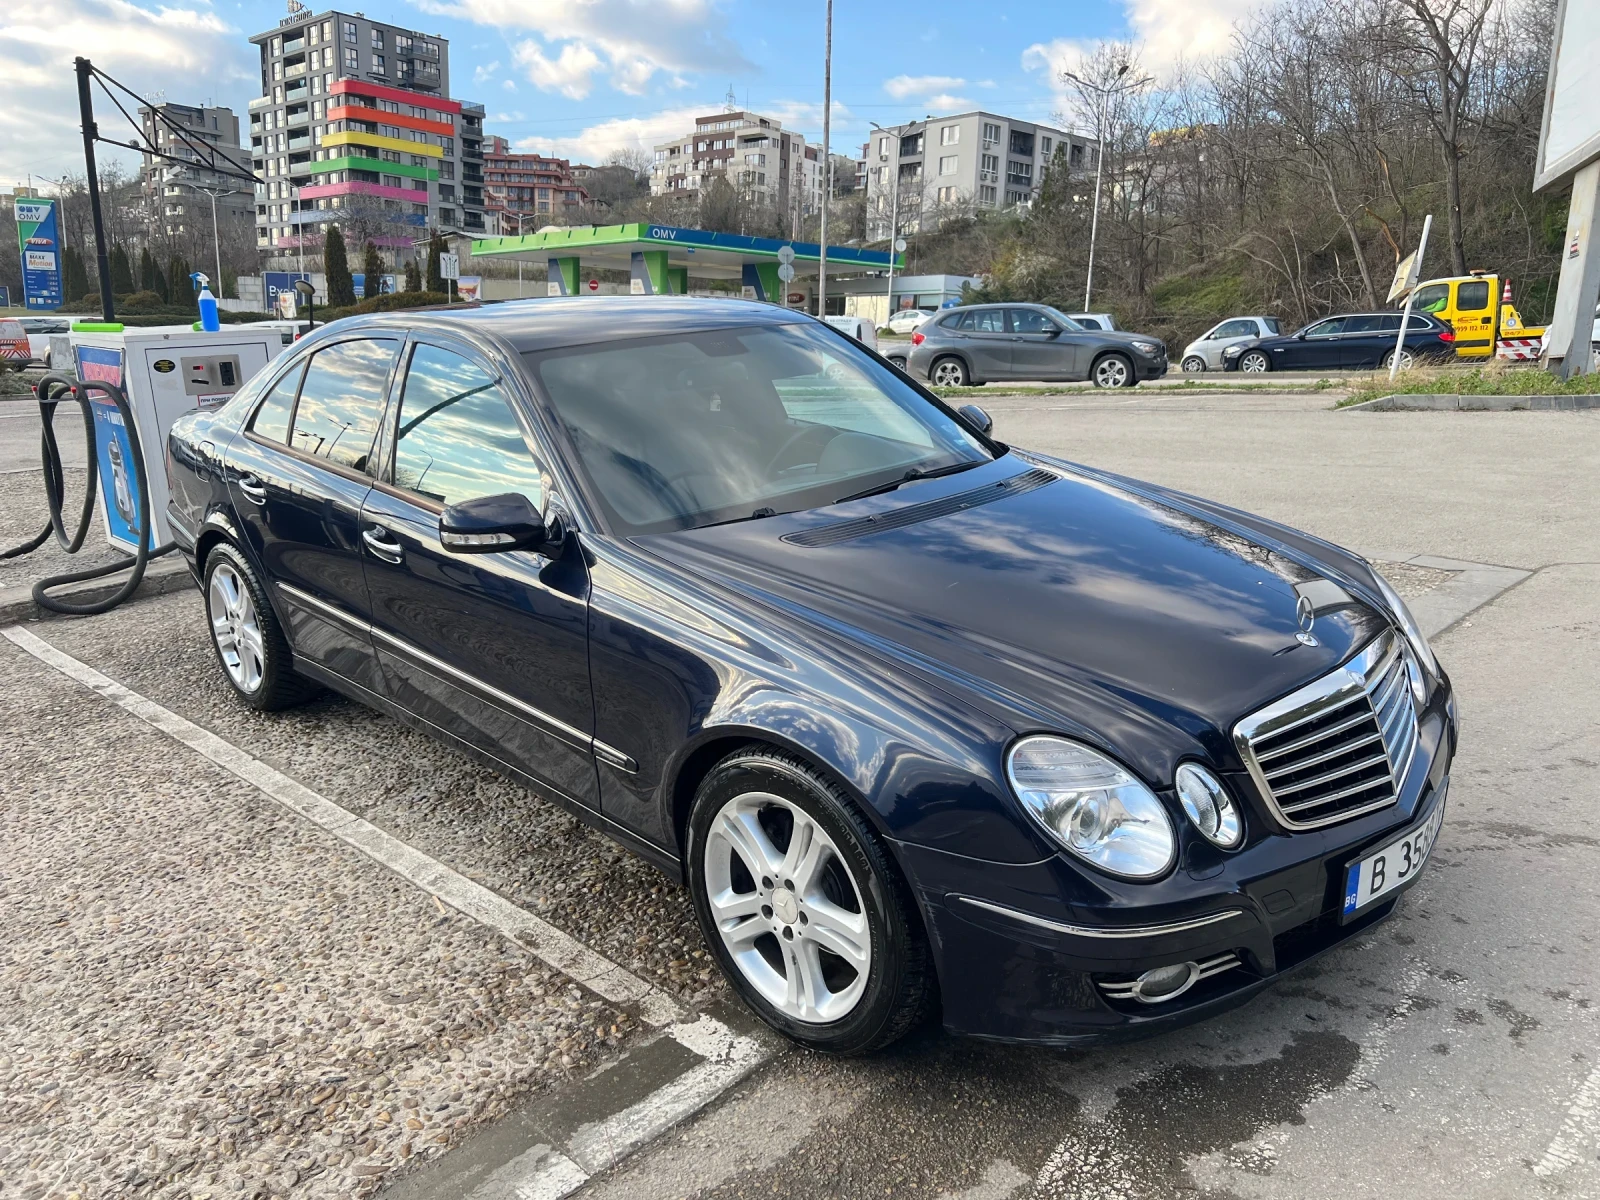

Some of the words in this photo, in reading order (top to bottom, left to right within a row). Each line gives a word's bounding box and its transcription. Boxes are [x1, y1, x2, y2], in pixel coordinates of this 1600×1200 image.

[18, 213, 41, 221] OMV
[652, 228, 677, 240] OMV
[28, 259, 53, 267] Motion
[1370, 855, 1386, 895] B
[1345, 893, 1356, 907] BG
